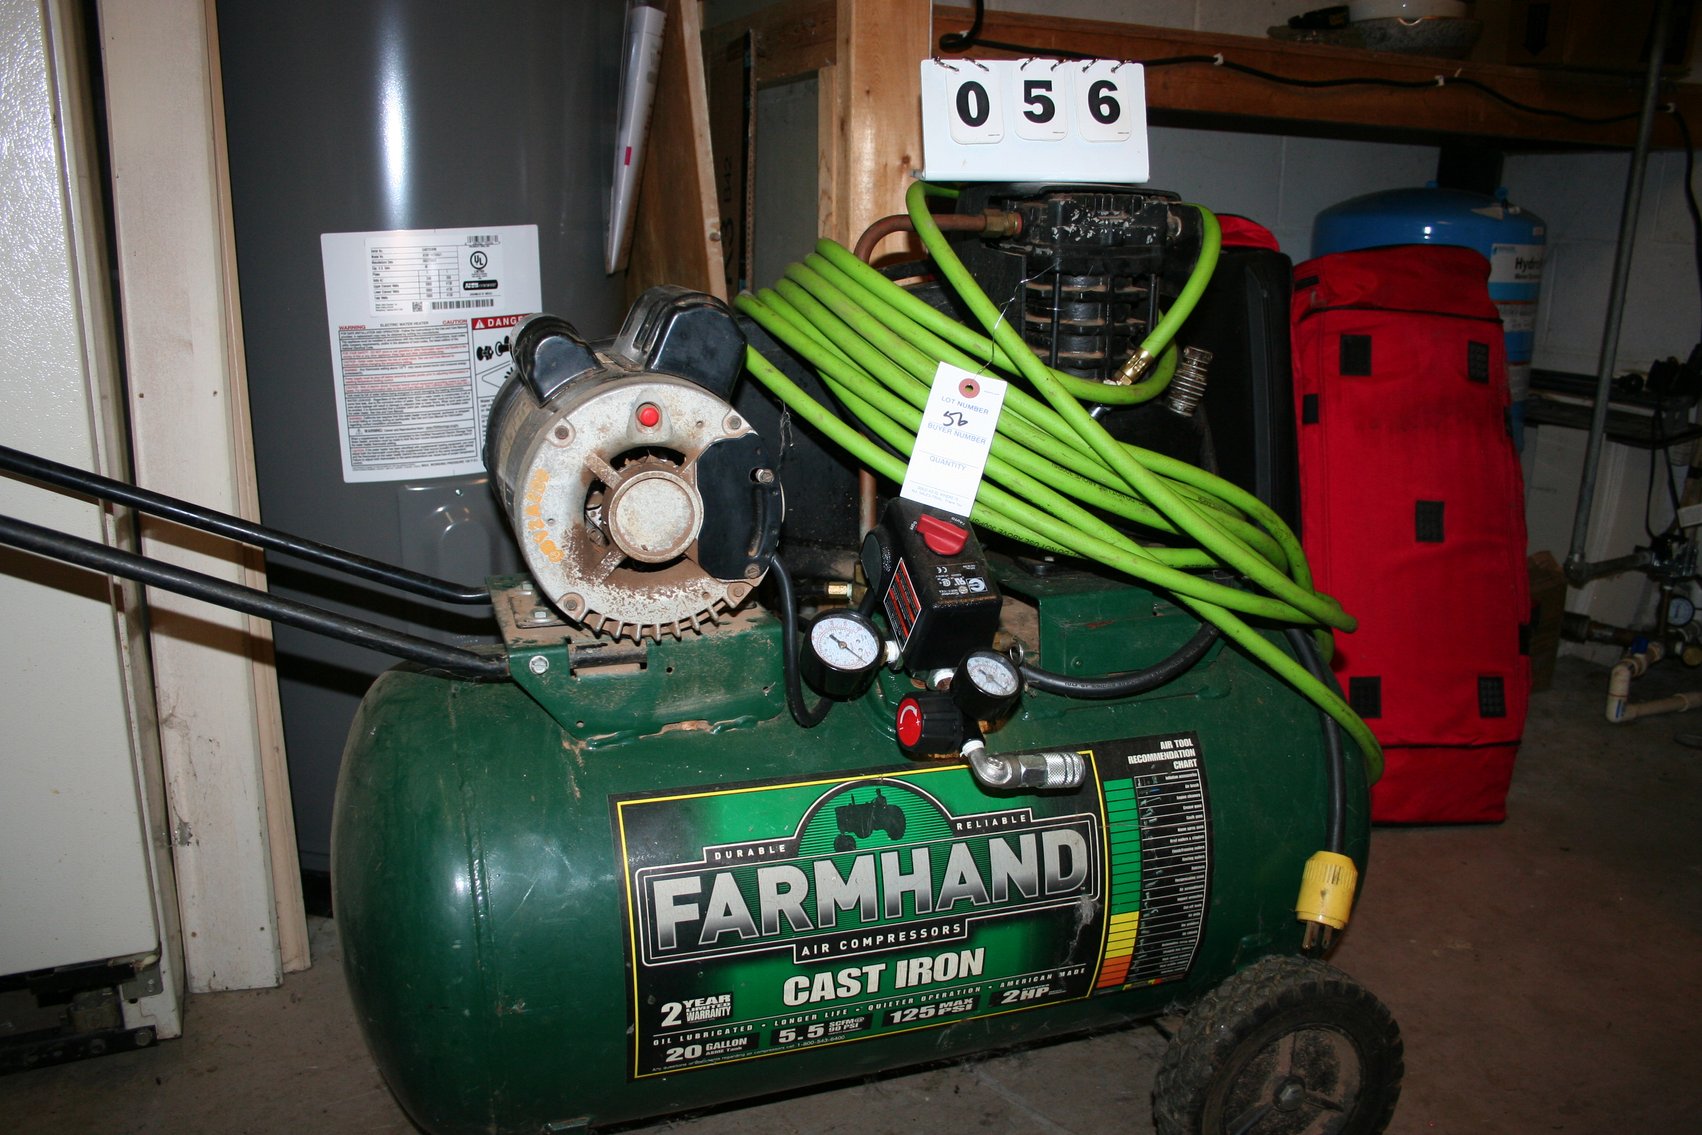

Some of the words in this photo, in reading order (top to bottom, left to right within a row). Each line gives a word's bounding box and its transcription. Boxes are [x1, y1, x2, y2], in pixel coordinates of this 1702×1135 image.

[956, 80, 990, 127] 0
[1023, 79, 1055, 124] 5
[1088, 79, 1121, 125] 6
[941, 395, 955, 405] LOT
[957, 401, 989, 415] NUMBER
[942, 410, 968, 427] 56
[927, 422, 952, 435] BUYER
[953, 430, 986, 445] NUMBER
[929, 455, 967, 472] QUANTITY
[1160, 740, 1173, 750] AIR
[1174, 738, 1194, 748] TOOL
[1127, 748, 1196, 765] RECOMMENDATION
[1173, 758, 1198, 770] CHART
[956, 814, 1027, 831] RELIABLE
[714, 844, 787, 861] DURABLE
[653, 829, 1088, 950] FARMHAND
[801, 943, 830, 957] AIR
[840, 923, 962, 951] COMPRESSORS
[783, 963, 887, 1007] CAST
[895, 947, 985, 989] IRON
[653, 1038, 672, 1046] OIL
[680, 1024, 753, 1042] LUBRICATED
[774, 1014, 818, 1027] LONGER
[824, 1008, 848, 1018] LIFE
[868, 997, 914, 1011] QUIETER
[921, 986, 981, 1002] OPERATION
[1000, 973, 1053, 988] AMERICAN
[1059, 967, 1085, 977] MADE
[682, 994, 731, 1008] YEAR
[937, 1003, 973, 1016] PSI
[938, 997, 974, 1009] MAX
[661, 1002, 683, 1028] 2
[686, 1006, 732, 1022] WARRANTY
[890, 1004, 936, 1024] 125
[778, 1023, 825, 1044] 5.5
[705, 1037, 748, 1051] GALLON
[666, 1044, 702, 1063] 20
